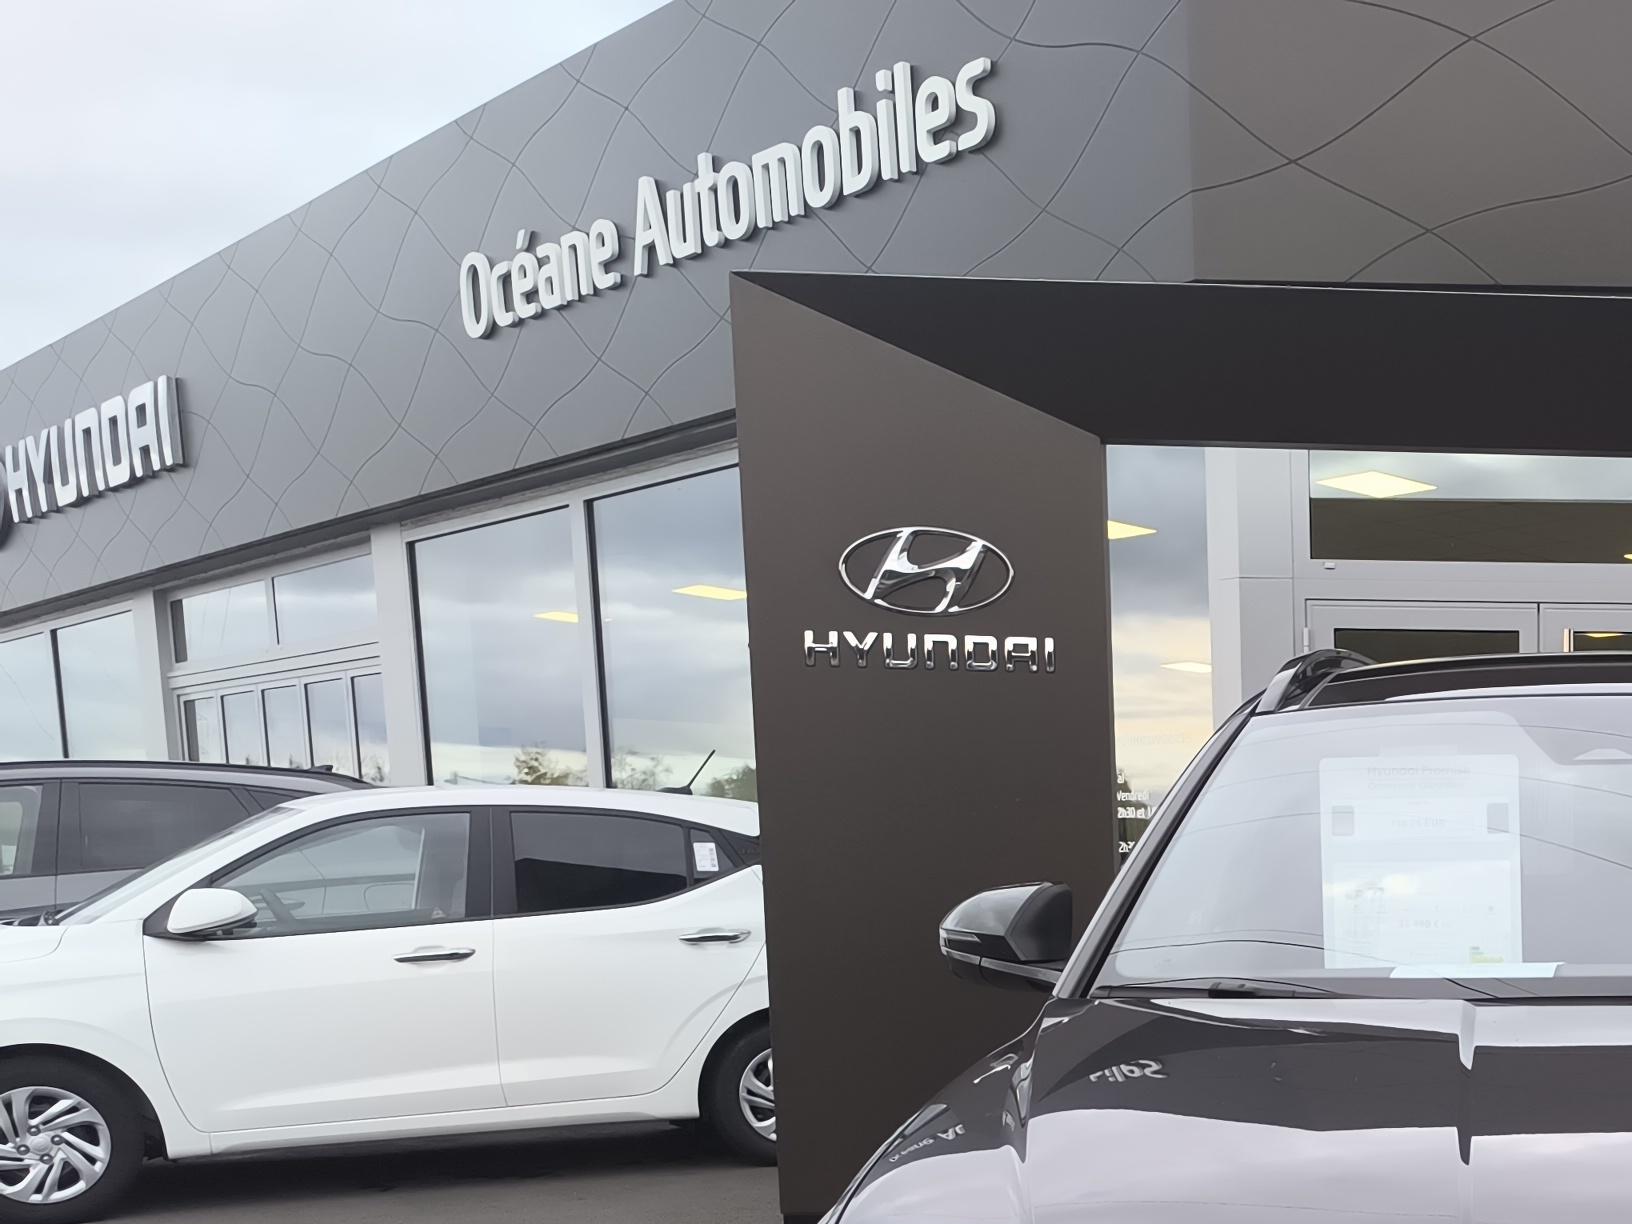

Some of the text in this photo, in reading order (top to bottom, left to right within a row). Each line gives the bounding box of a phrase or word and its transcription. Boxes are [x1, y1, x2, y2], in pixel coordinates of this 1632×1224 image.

[459, 57, 997, 339] Océane Automobiles
[4, 374, 183, 524] HYUNDAI
[803, 629, 1056, 673] HYUNDAI
